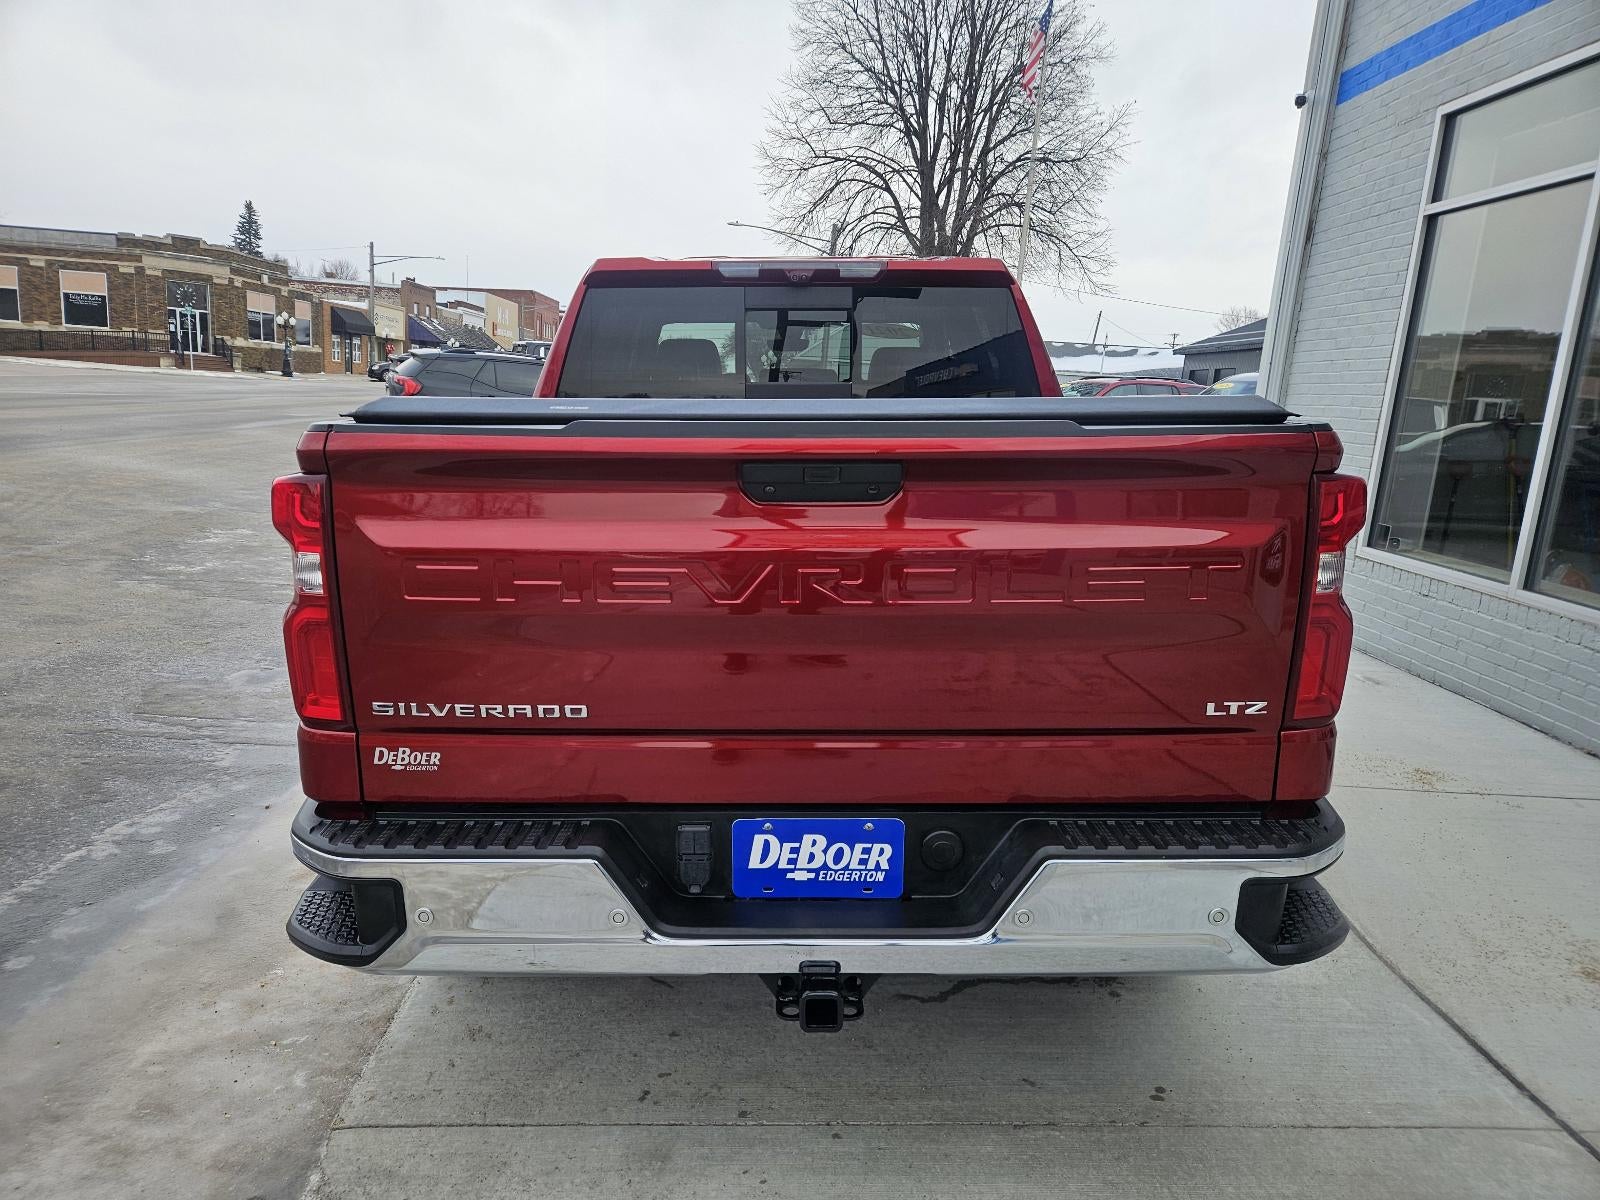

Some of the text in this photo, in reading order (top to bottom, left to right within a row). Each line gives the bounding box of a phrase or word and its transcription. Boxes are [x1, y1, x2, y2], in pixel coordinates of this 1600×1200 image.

[403, 554, 1244, 604] CHEVROLET
[371, 701, 589, 719] SILVERADO
[1205, 700, 1269, 716] LTZ
[818, 870, 886, 882] EDGERTON
